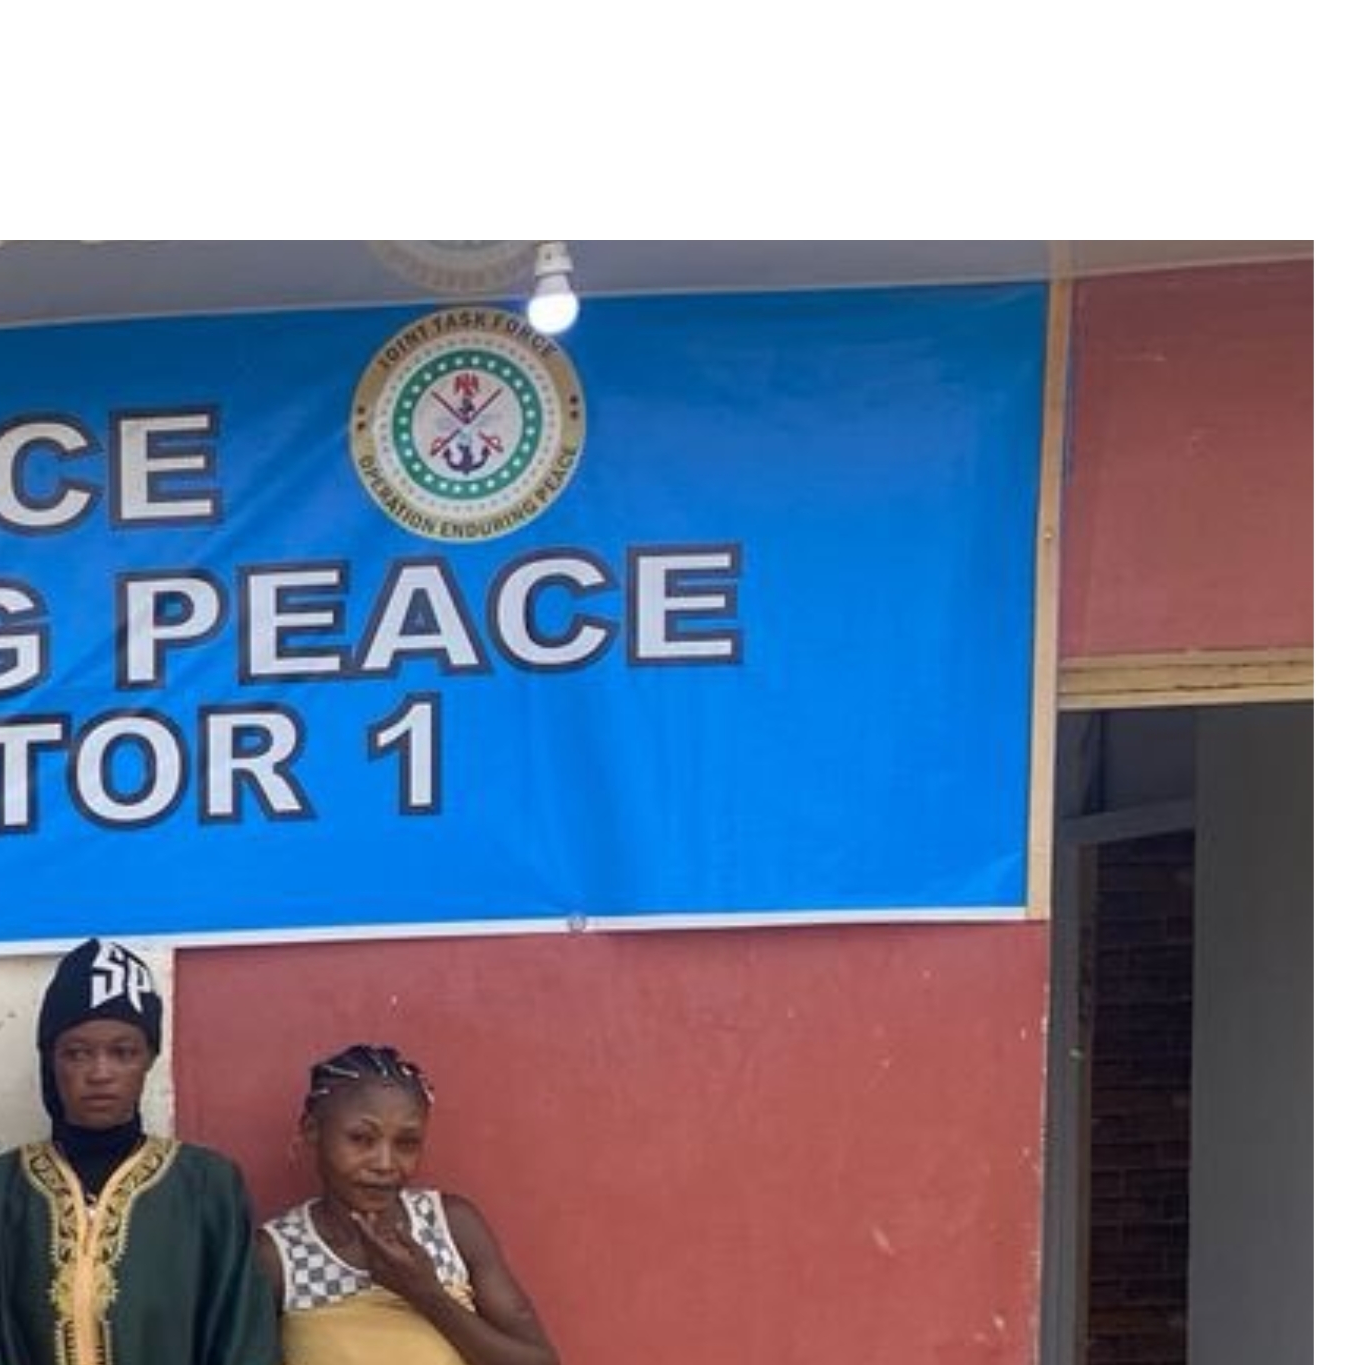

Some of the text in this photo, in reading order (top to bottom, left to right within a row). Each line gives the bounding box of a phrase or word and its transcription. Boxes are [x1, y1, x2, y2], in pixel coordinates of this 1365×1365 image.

[377, 311, 559, 370] JOINT TASK FORCE
[117, 540, 744, 692] PEACE
[368, 690, 443, 816] 1
